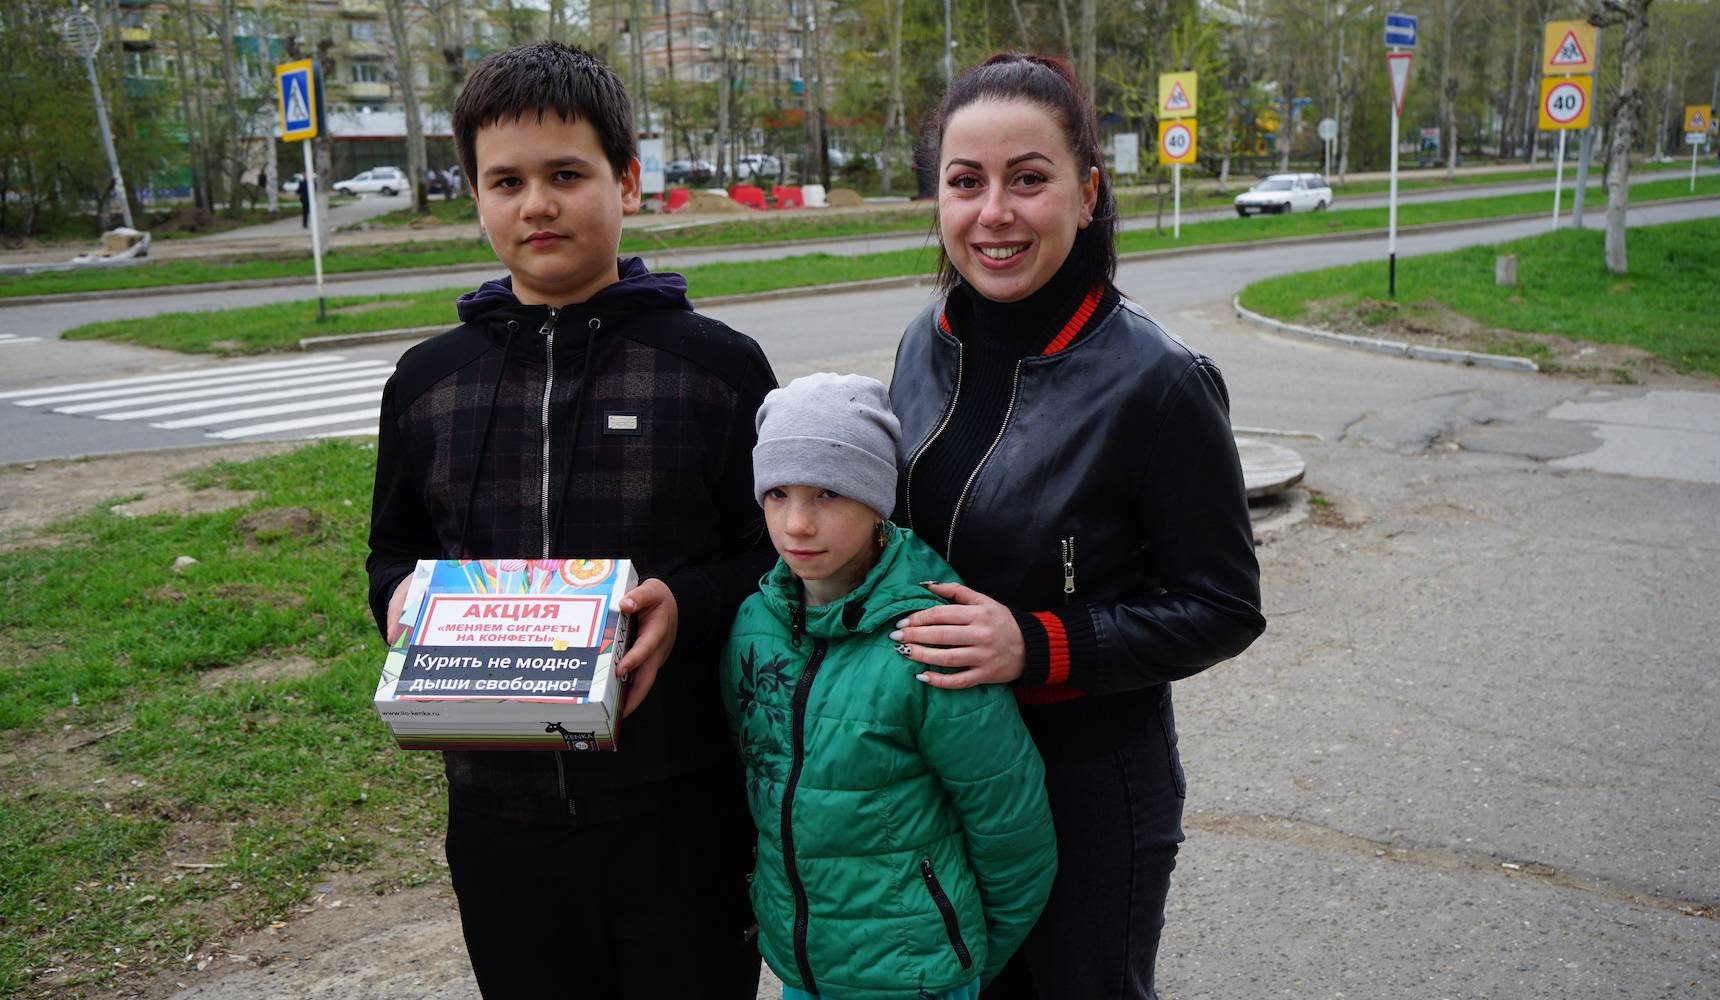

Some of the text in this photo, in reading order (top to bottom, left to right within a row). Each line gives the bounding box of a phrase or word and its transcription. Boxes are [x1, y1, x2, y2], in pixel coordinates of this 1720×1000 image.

[1553, 95, 1576, 110] 40
[1168, 134, 1186, 148] 40
[463, 604, 561, 621] АКЦИЯ
[437, 623, 581, 633] «МЕНЯЕМ СИГАРЕТЫ
[455, 633, 555, 643] НА КОНФЕТЫ»
[413, 653, 588, 671] Курить не модно-
[409, 677, 578, 693] дыши свободно!
